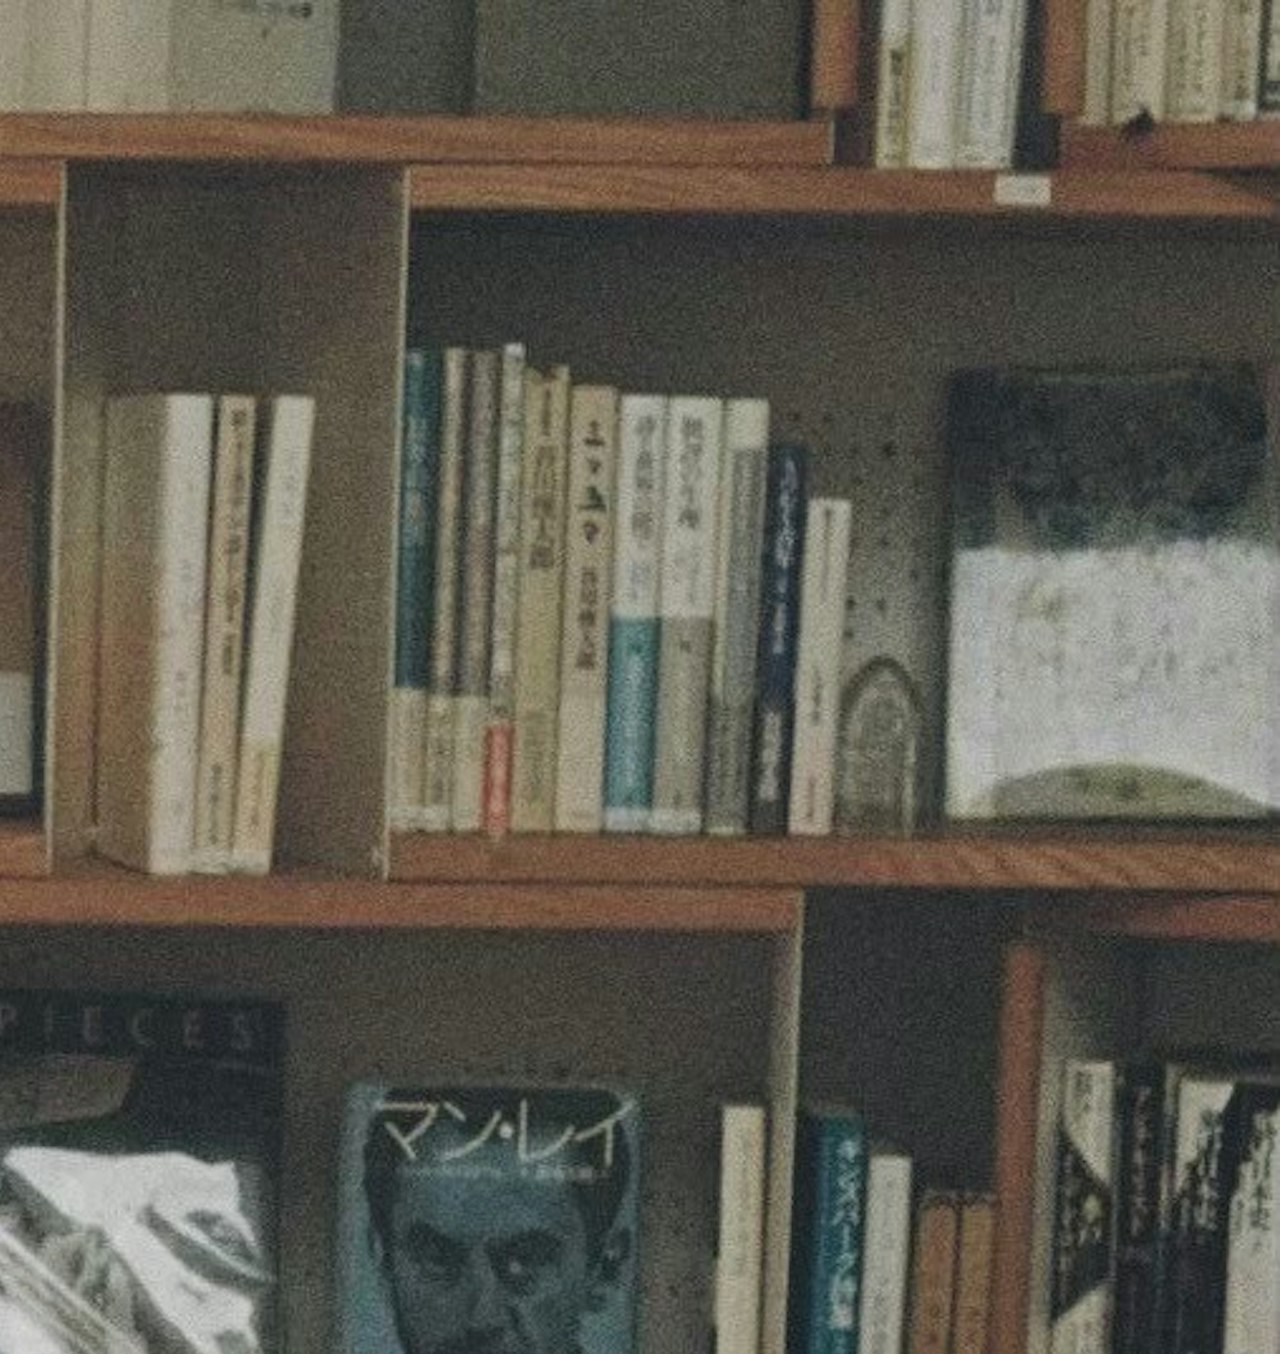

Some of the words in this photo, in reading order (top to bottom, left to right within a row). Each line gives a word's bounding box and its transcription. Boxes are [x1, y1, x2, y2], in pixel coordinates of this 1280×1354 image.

[376, 1098, 637, 1168] マン・レイ
